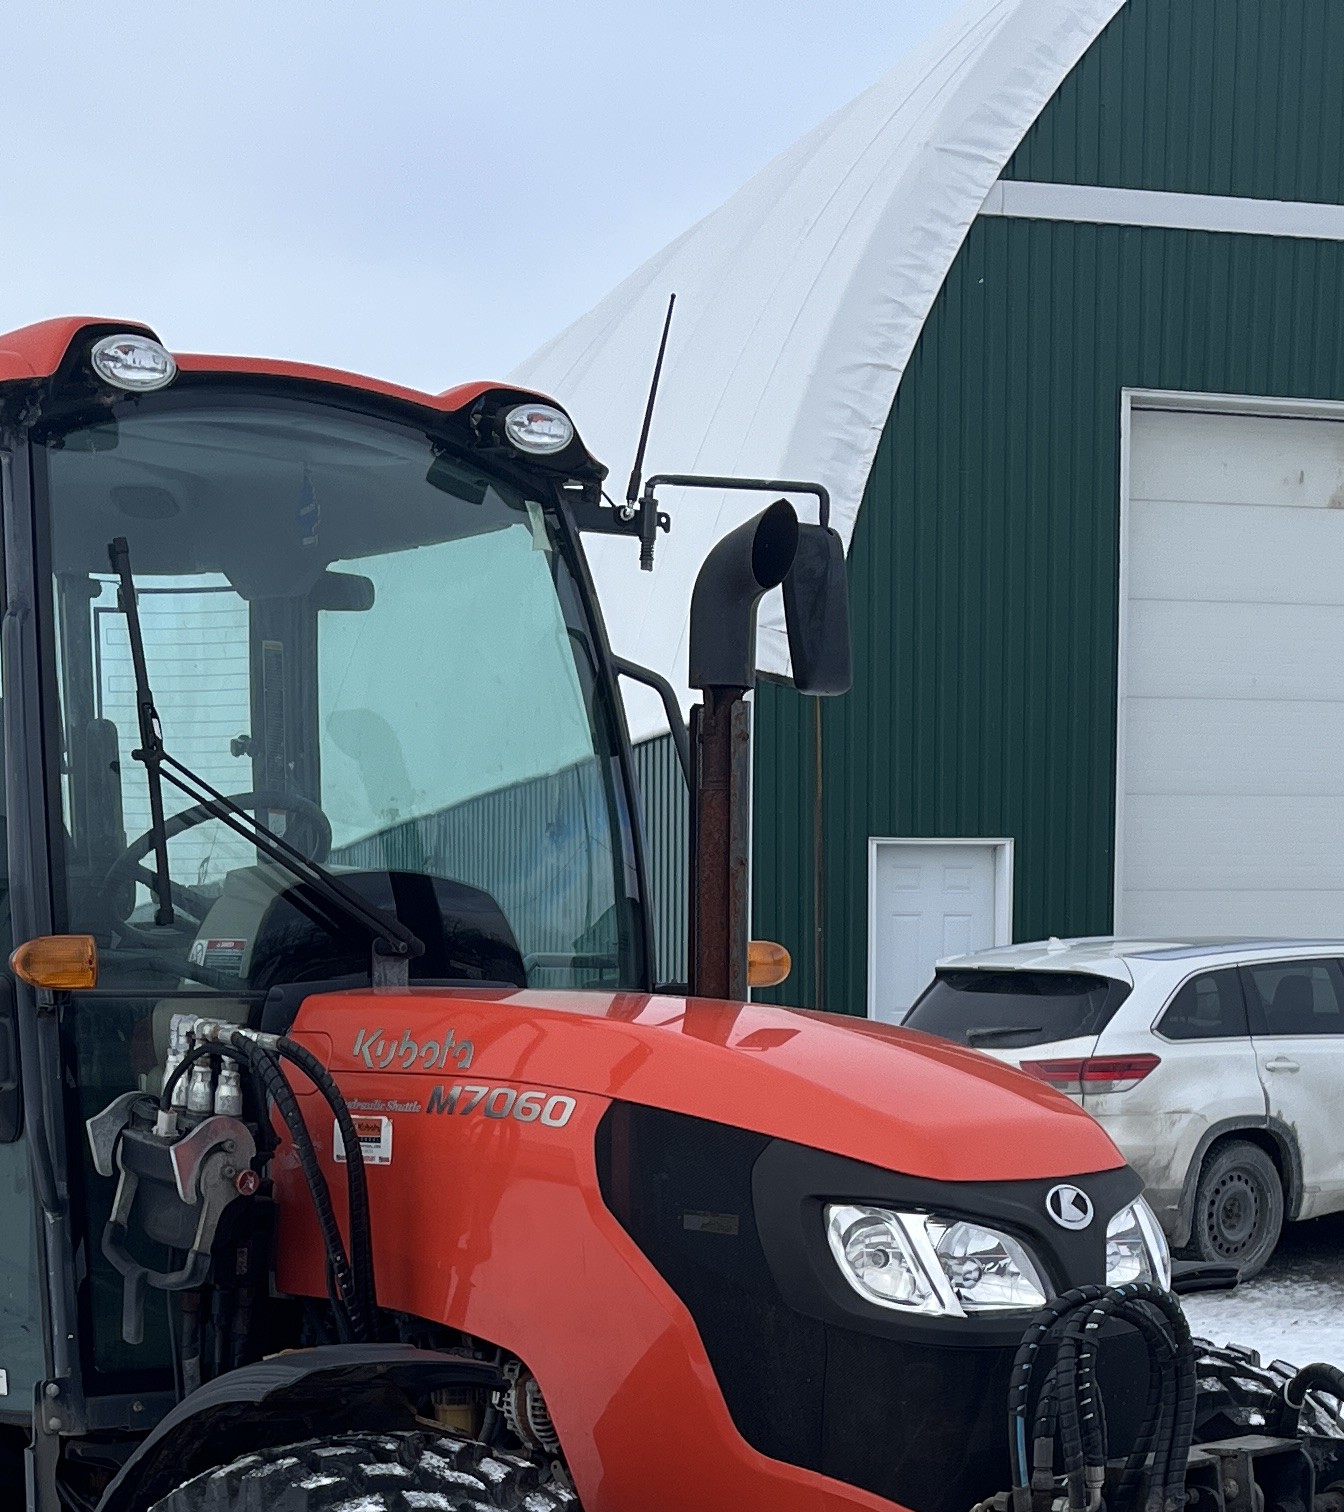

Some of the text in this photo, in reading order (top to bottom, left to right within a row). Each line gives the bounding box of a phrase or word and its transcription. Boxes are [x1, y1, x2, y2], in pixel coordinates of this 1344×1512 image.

[352, 1028, 475, 1069] Kubota
[386, 1100, 422, 1112] Shuttle
[426, 1084, 577, 1128] M7060
